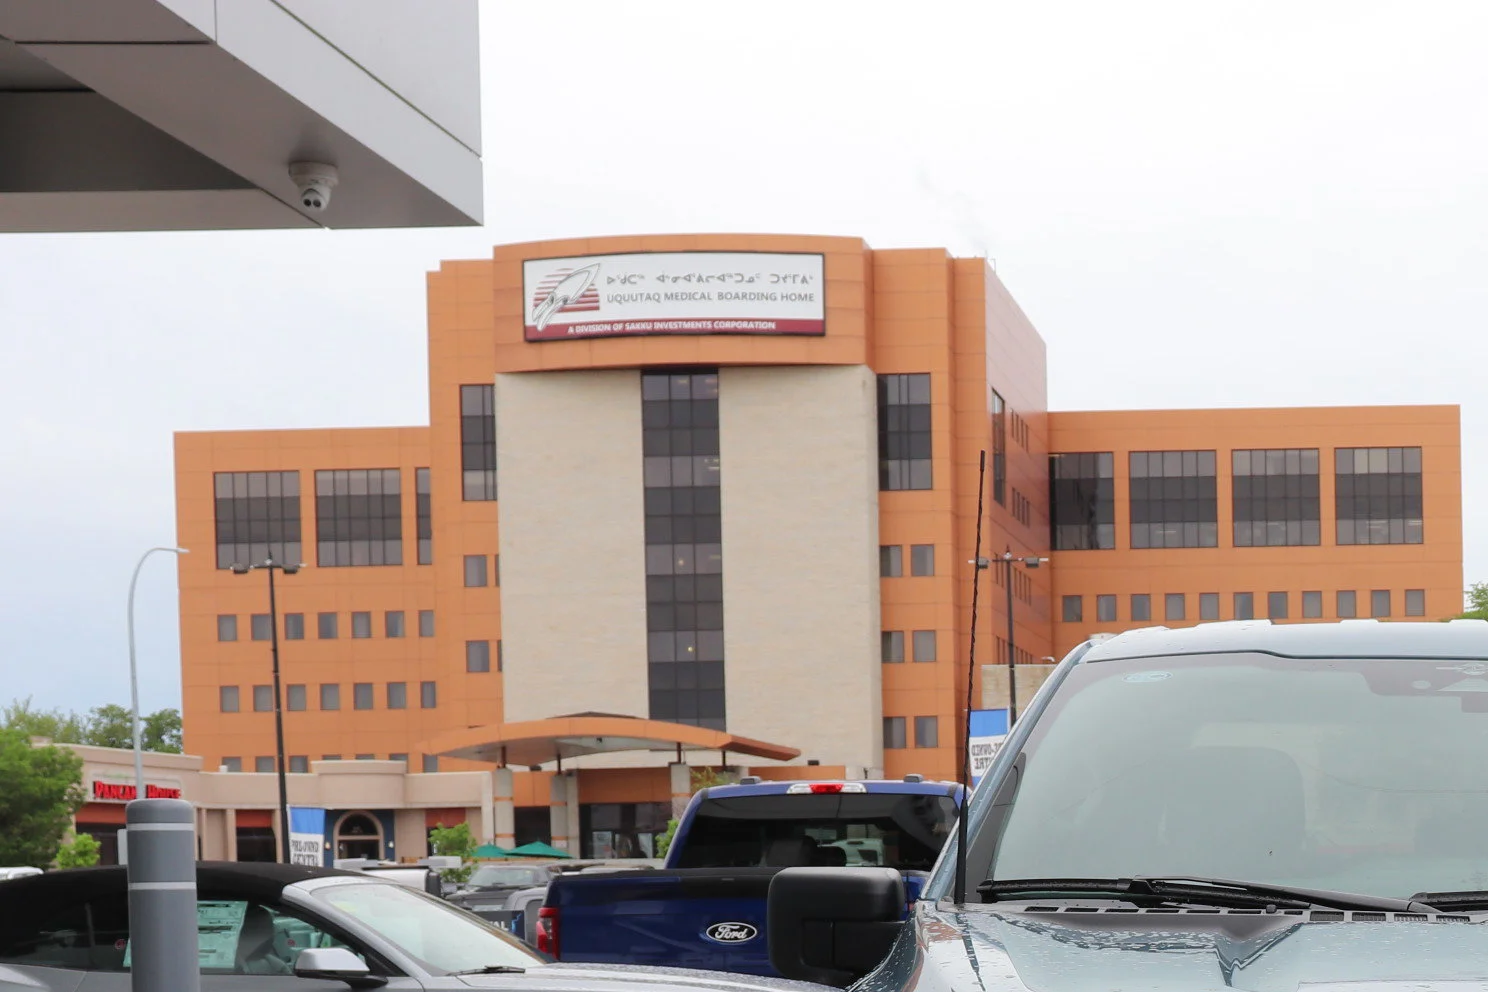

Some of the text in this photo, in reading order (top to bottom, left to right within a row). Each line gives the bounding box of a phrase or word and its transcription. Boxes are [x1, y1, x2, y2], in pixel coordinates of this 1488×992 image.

[606, 291, 815, 305] UQUUTAQ MEDICAL BOARDING HOME
[567, 320, 776, 334] A DIVISION OF SAKKU INVESTMENTS CORPORATION
[714, 924, 748, 939] Ford
